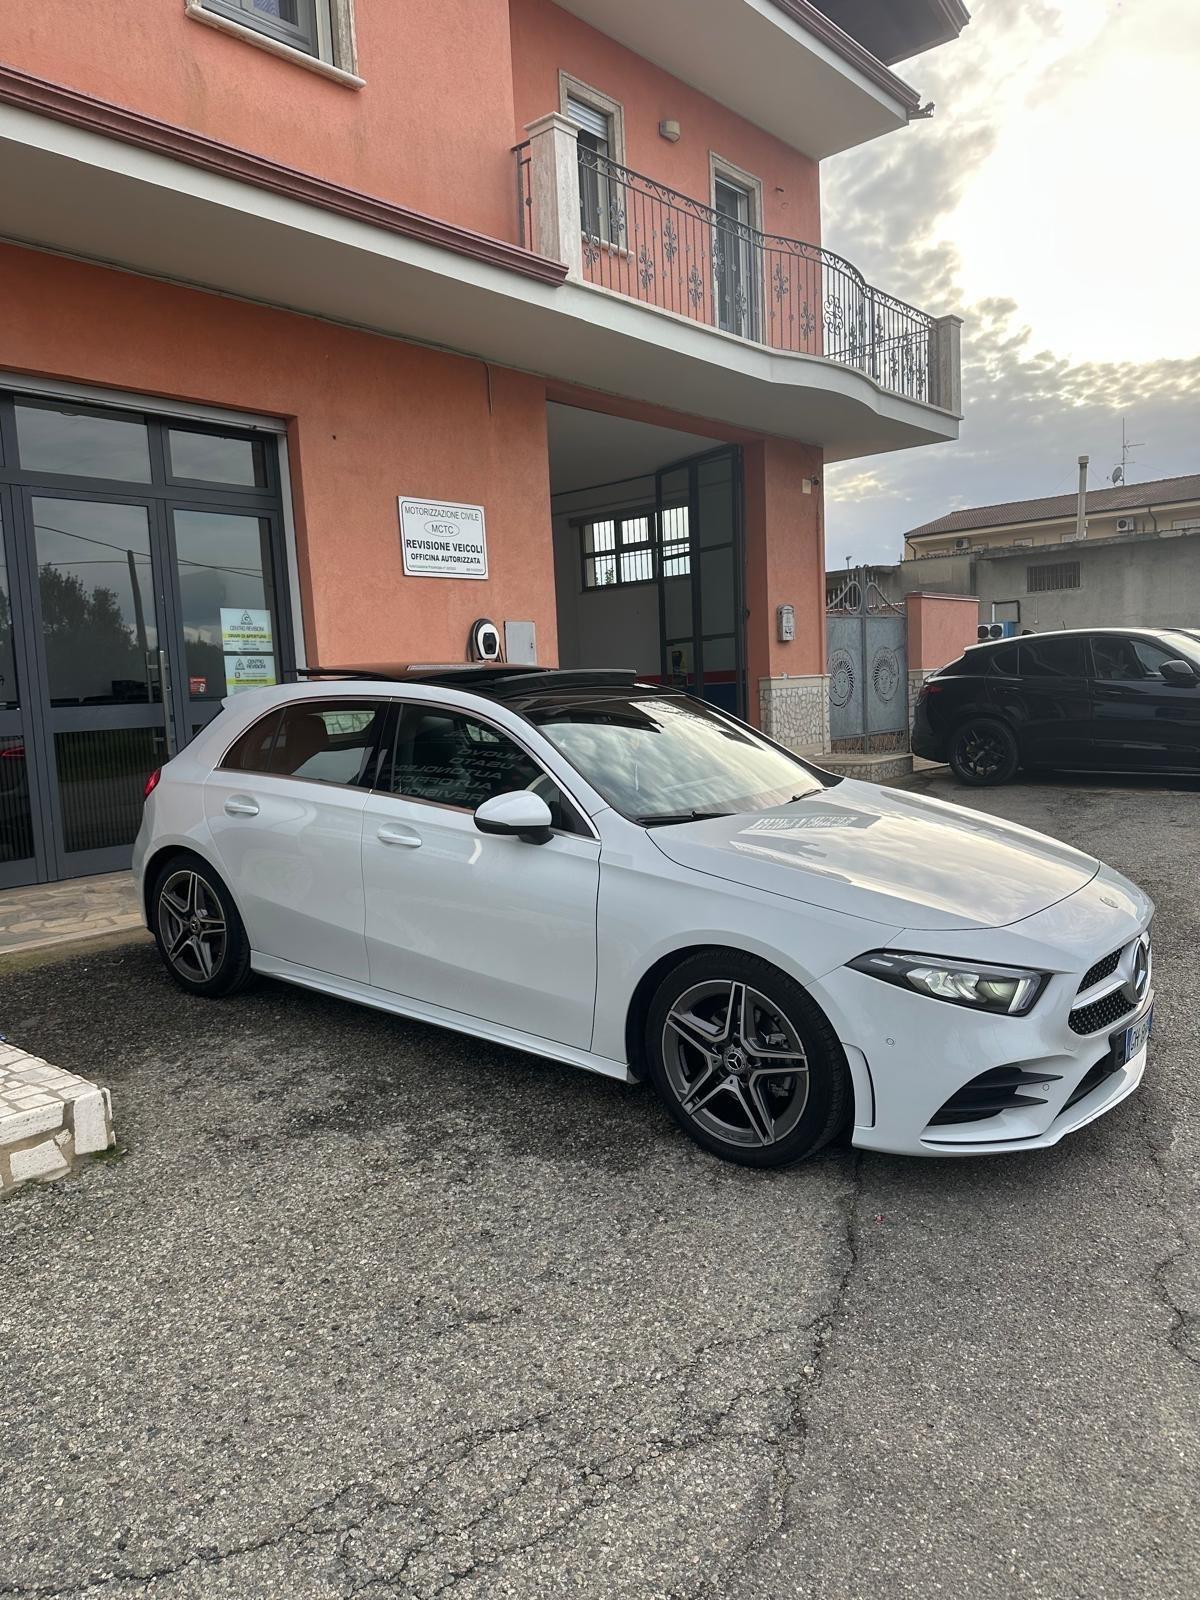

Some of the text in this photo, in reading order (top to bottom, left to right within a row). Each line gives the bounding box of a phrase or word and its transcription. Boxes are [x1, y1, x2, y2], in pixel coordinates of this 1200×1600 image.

[404, 506, 480, 521] MOTORIZZAZIONE CIVILE
[431, 524, 454, 534] MCTC
[406, 539, 483, 553] REVISIONE VEICOLI
[410, 553, 481, 564] OFFICINA AUTORIZZATA
